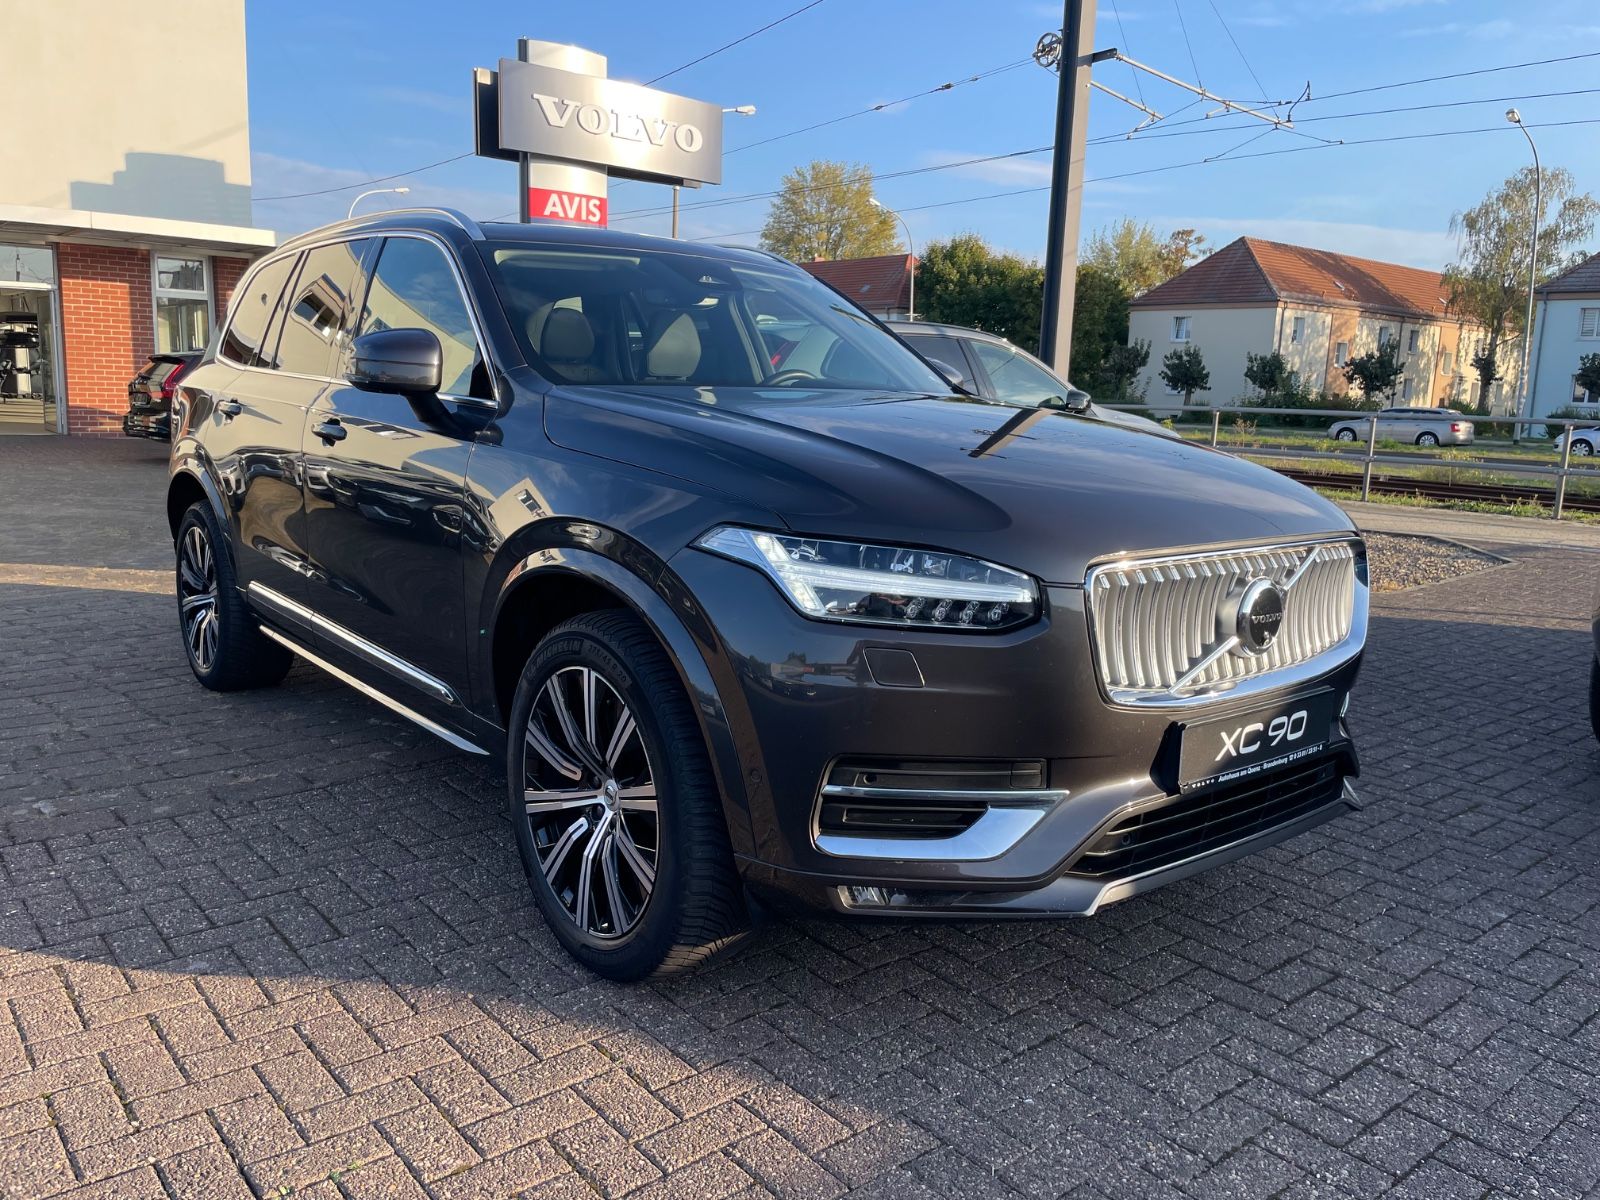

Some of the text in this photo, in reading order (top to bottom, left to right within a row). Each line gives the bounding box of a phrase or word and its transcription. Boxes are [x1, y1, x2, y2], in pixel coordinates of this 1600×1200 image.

[531, 93, 703, 153] VOLVO
[543, 193, 601, 223] AVIS
[1251, 612, 1282, 624] VOLVO
[536, 639, 581, 666] MICHELIN
[1214, 710, 1307, 761] XC 90
[1217, 772, 1240, 783] Autohaus
